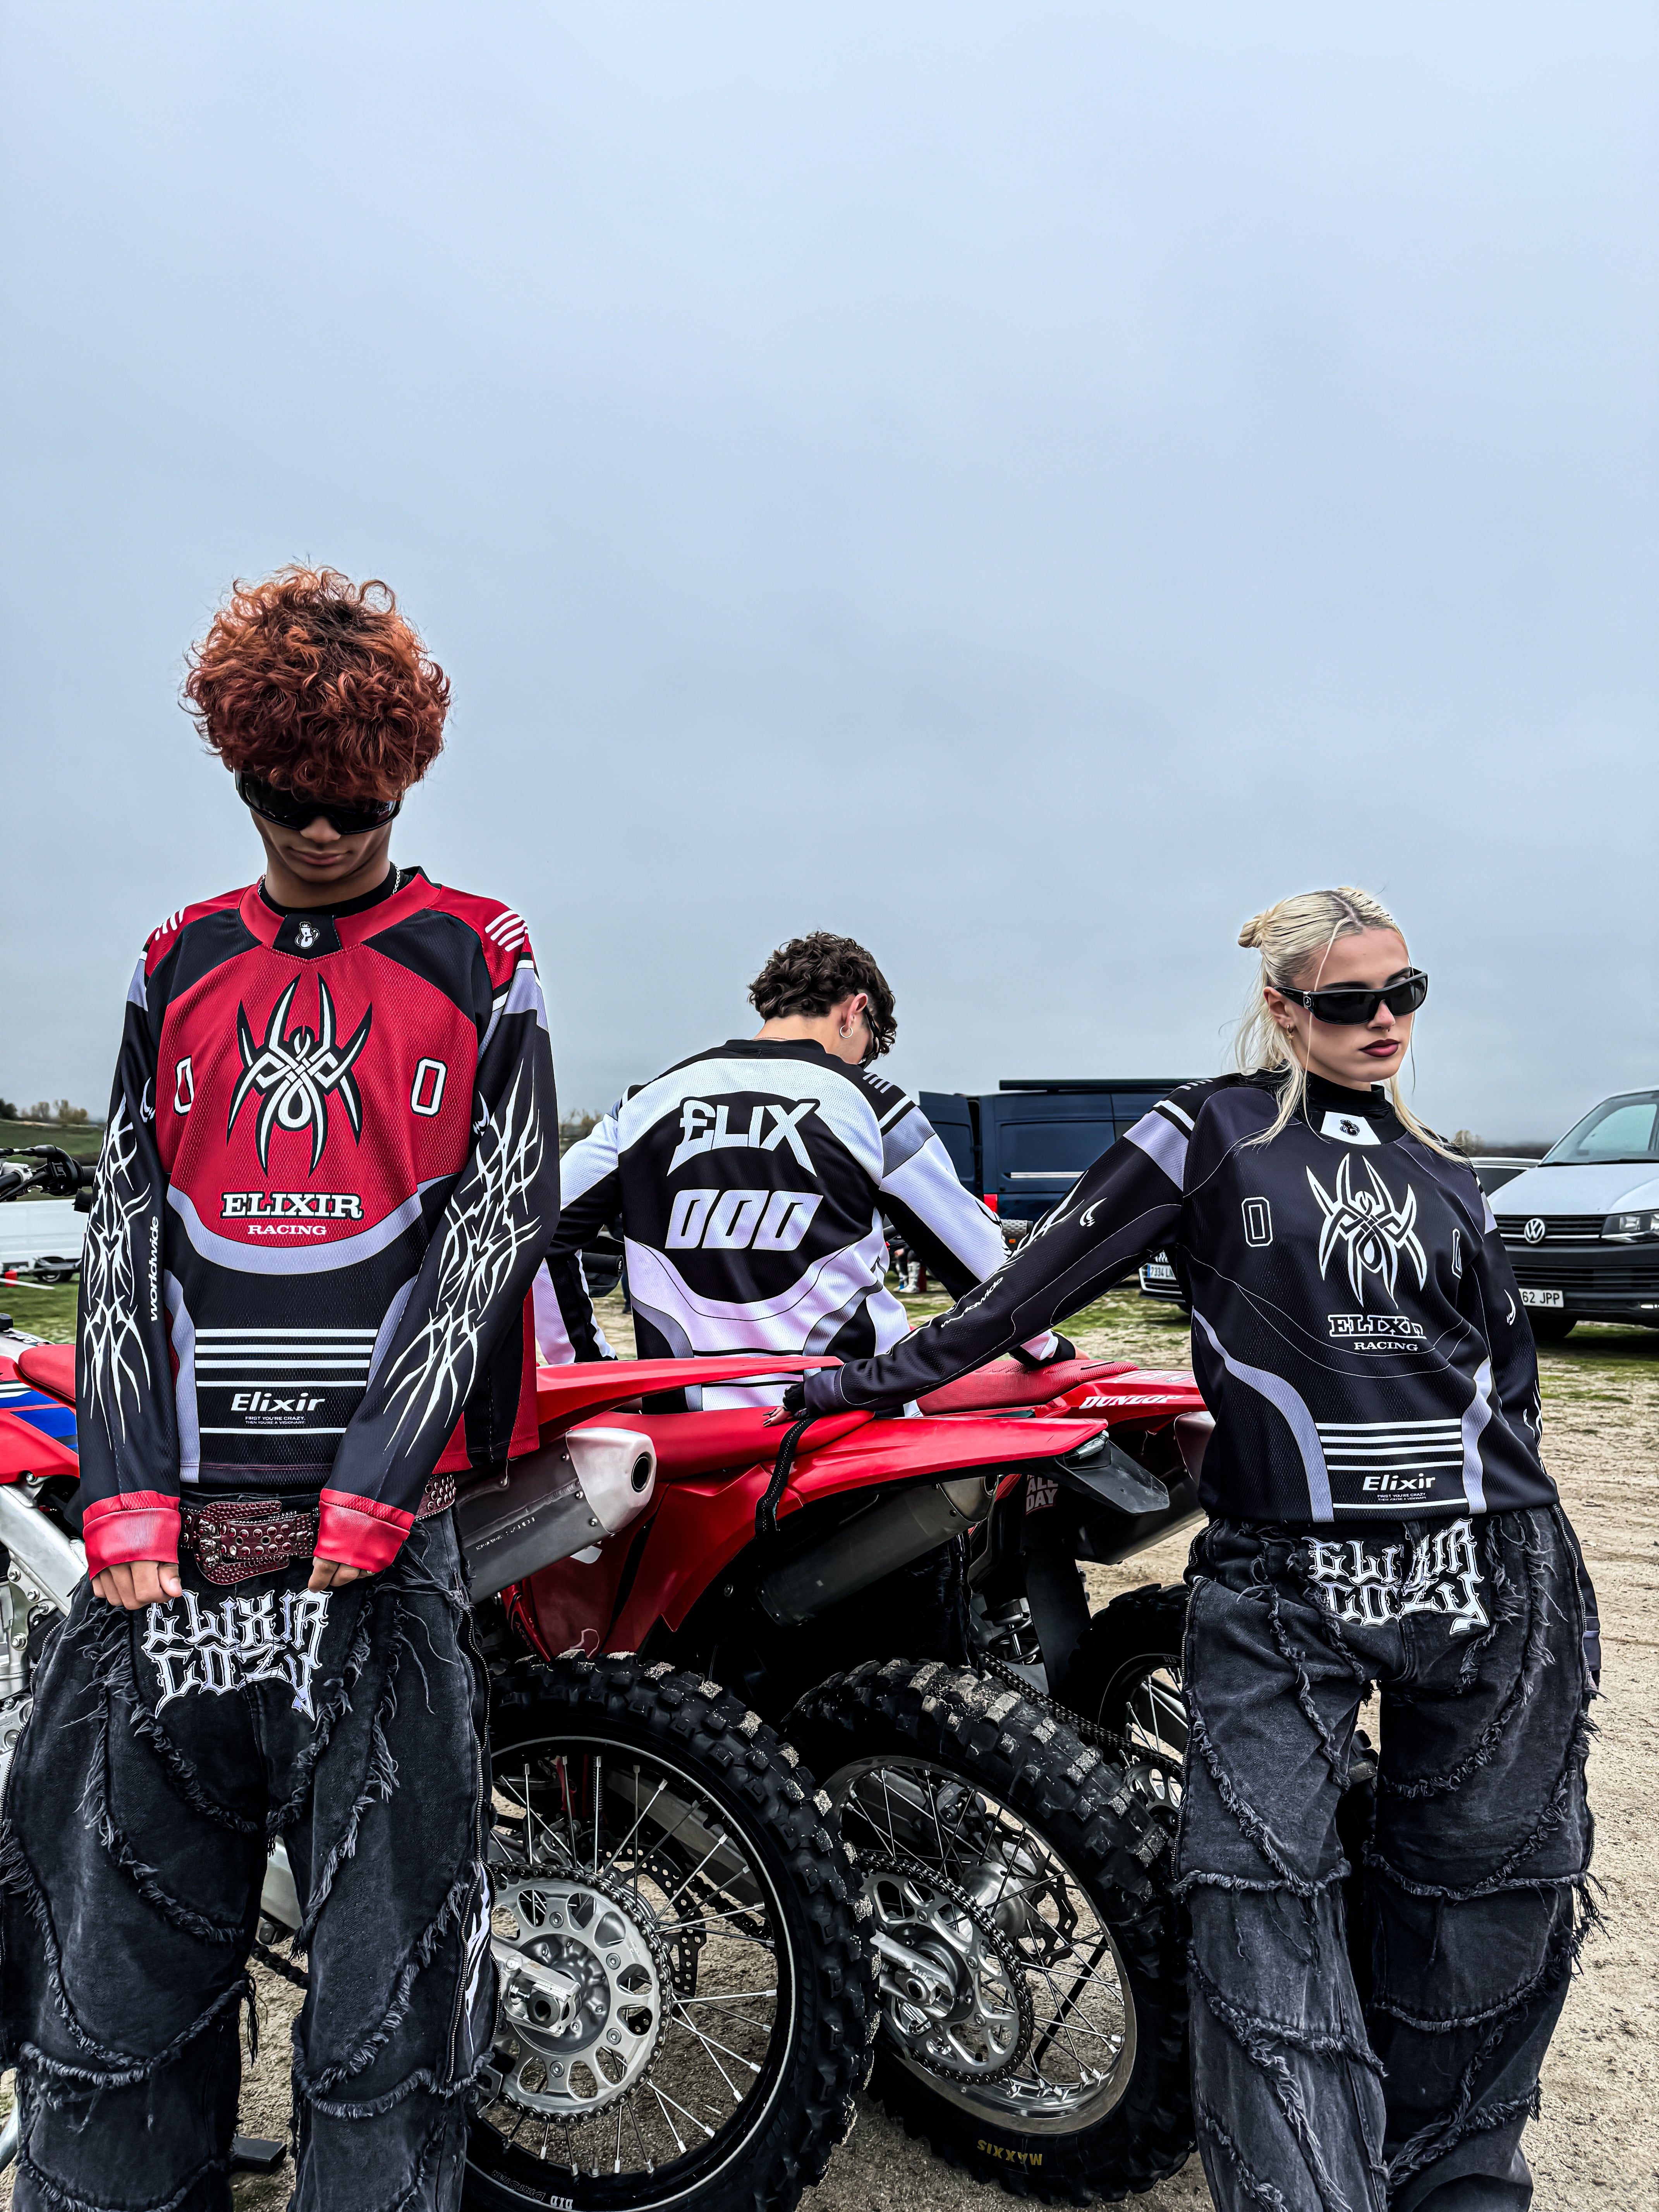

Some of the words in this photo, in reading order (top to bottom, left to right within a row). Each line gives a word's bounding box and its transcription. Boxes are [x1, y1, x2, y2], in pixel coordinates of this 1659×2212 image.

[410, 1056, 448, 1118] 0
[221, 1192, 363, 1220] ELIXIR
[247, 1224, 327, 1235] RACING
[148, 1216, 159, 1321] worldwide
[1539, 1292, 1560, 1305] JPP
[1354, 1341, 1418, 1352] RACING
[231, 1391, 326, 1412] Elixir
[1079, 1395, 1184, 1409] DUNLOP
[1026, 1477, 1058, 1496] ALL
[1362, 1473, 1436, 1491] Elixir
[1026, 1488, 1058, 1512] DAY
[141, 1589, 333, 1652] ELIXIR
[146, 1642, 323, 1721] COZY
[977, 2140, 1042, 2166] MAXXIS
